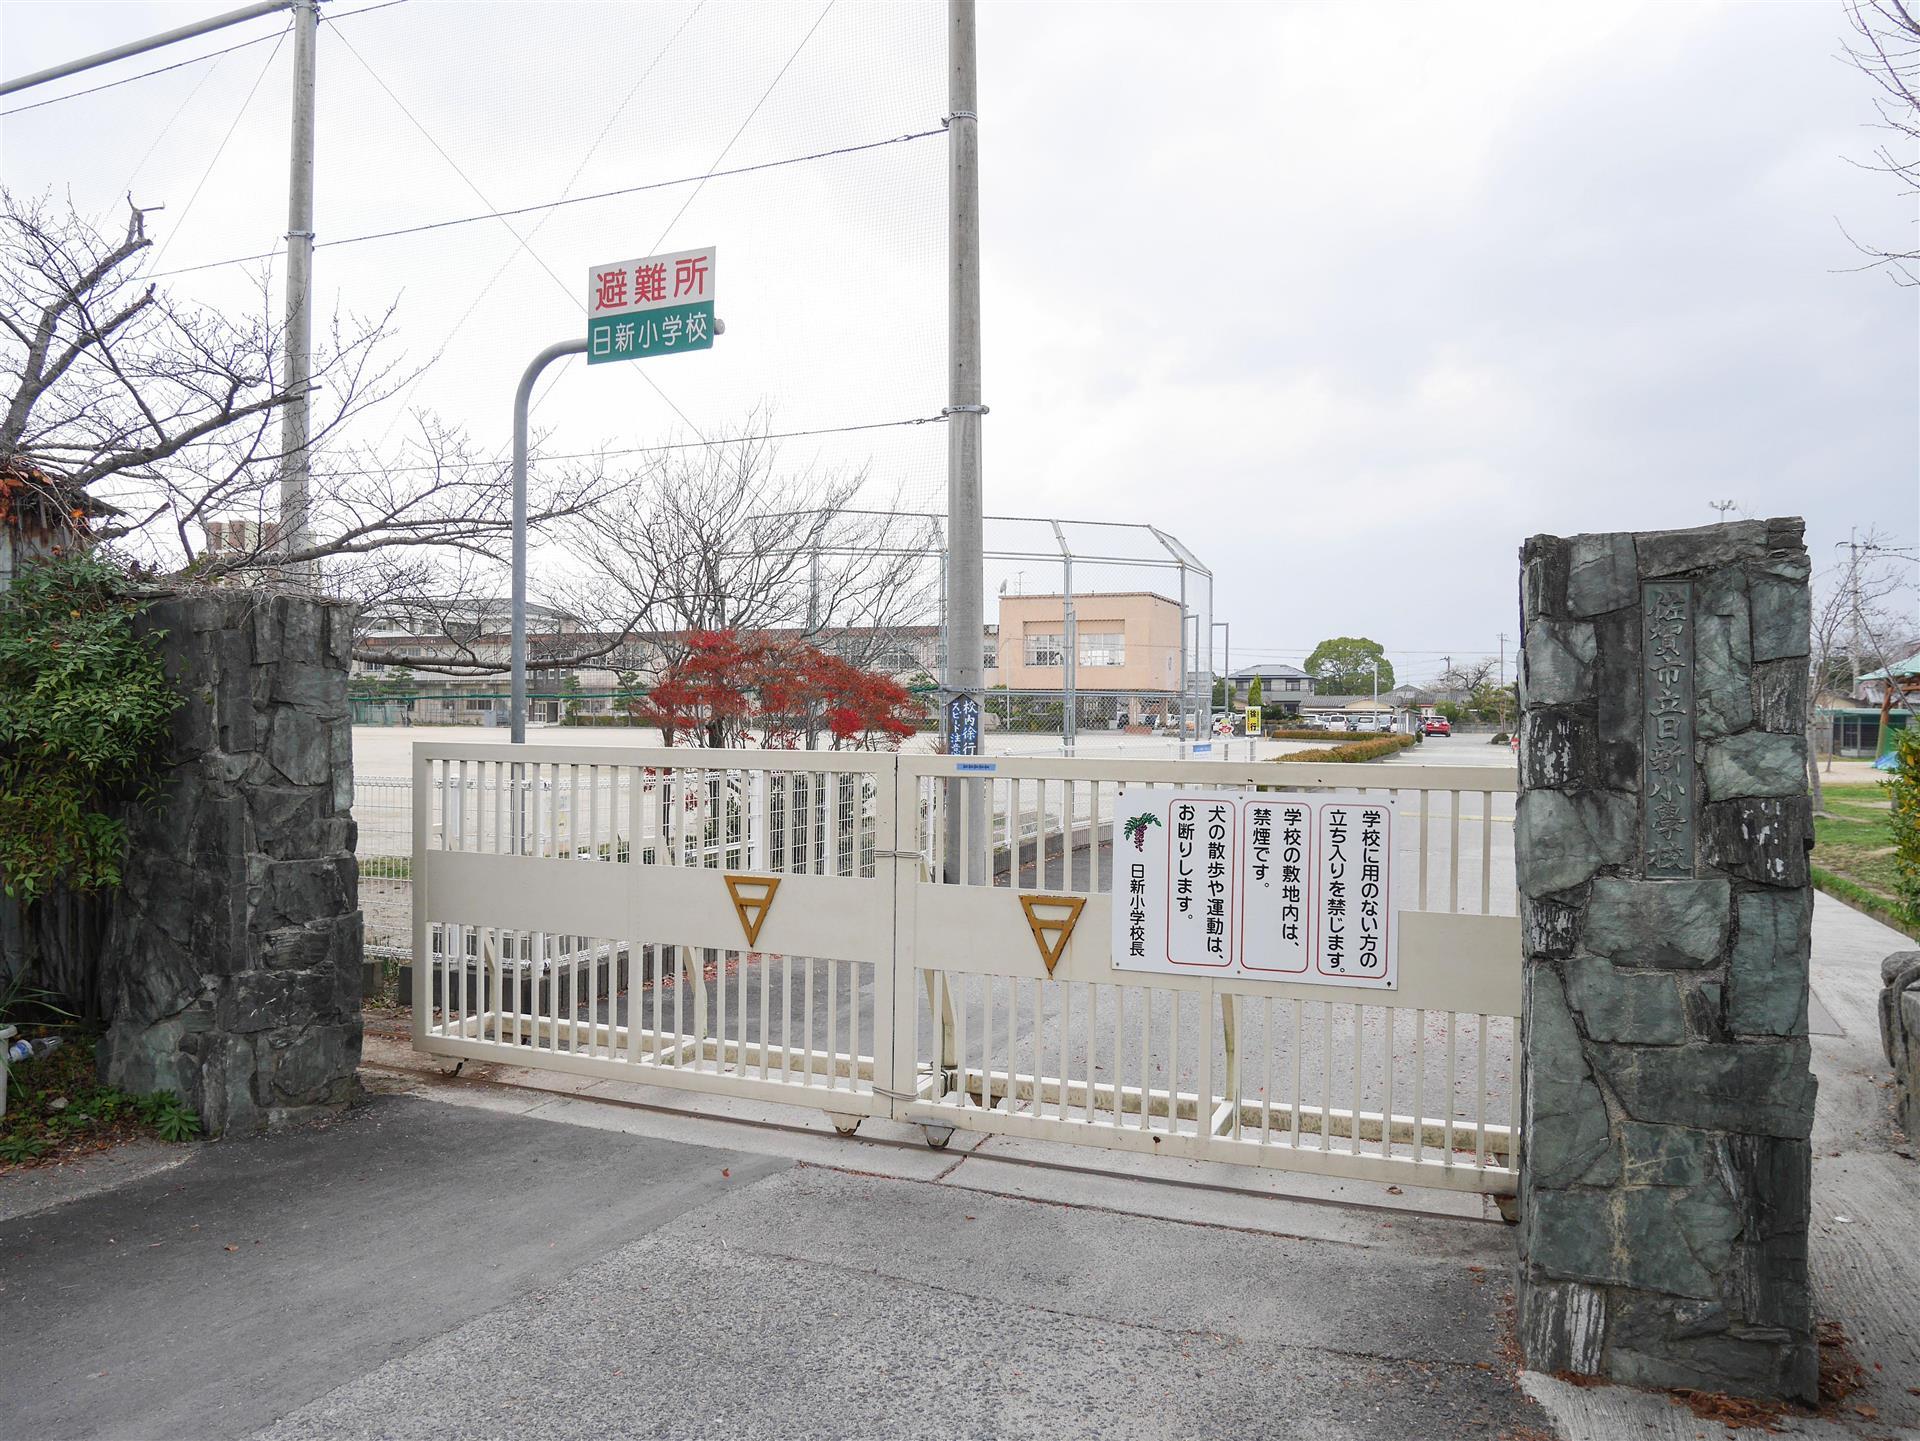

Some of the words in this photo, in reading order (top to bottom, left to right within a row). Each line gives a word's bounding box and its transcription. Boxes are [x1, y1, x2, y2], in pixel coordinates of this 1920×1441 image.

[593, 312, 707, 355] 日新小学校
[595, 256, 708, 311] 避難所
[963, 700, 978, 755] 校内徐行
[1176, 804, 1196, 920] お断りします。
[1206, 805, 1226, 960] 犬の散歩や運動は、
[1252, 808, 1272, 888] 禁煙です。
[1282, 808, 1302, 947] 学校の敷地内は、
[1327, 809, 1348, 973] 立ち入りを禁じます。
[1360, 810, 1380, 969] 学校に用のない方の
[1129, 863, 1145, 957] 日新小学校長
